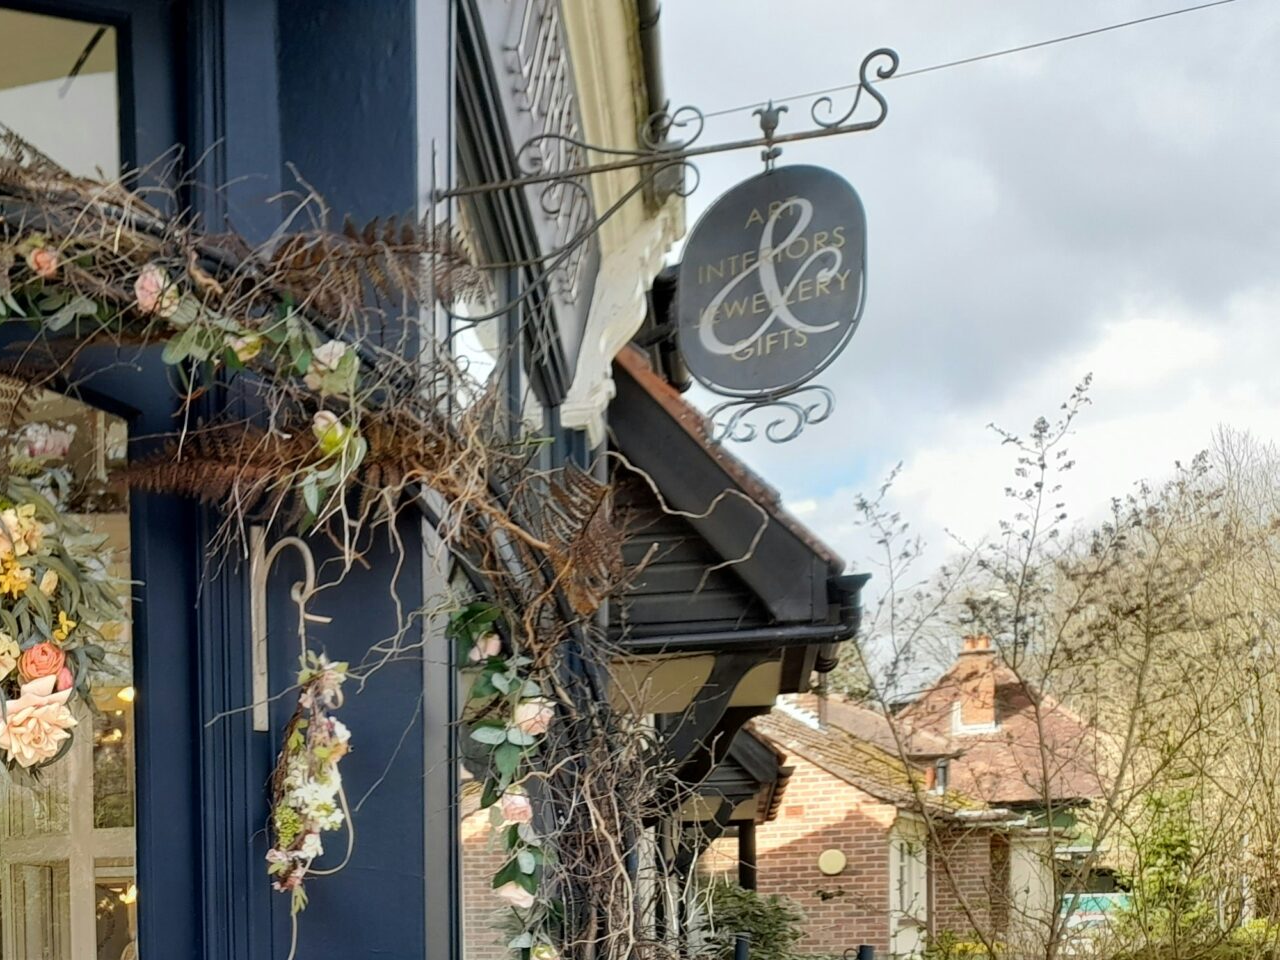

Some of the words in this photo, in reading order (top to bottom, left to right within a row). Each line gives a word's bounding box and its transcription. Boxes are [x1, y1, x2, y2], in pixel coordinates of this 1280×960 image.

[744, 196, 801, 230] ART
[697, 226, 846, 284] INTERIORS
[693, 269, 851, 329] JEWELLERY
[730, 327, 808, 361] GIFTS
